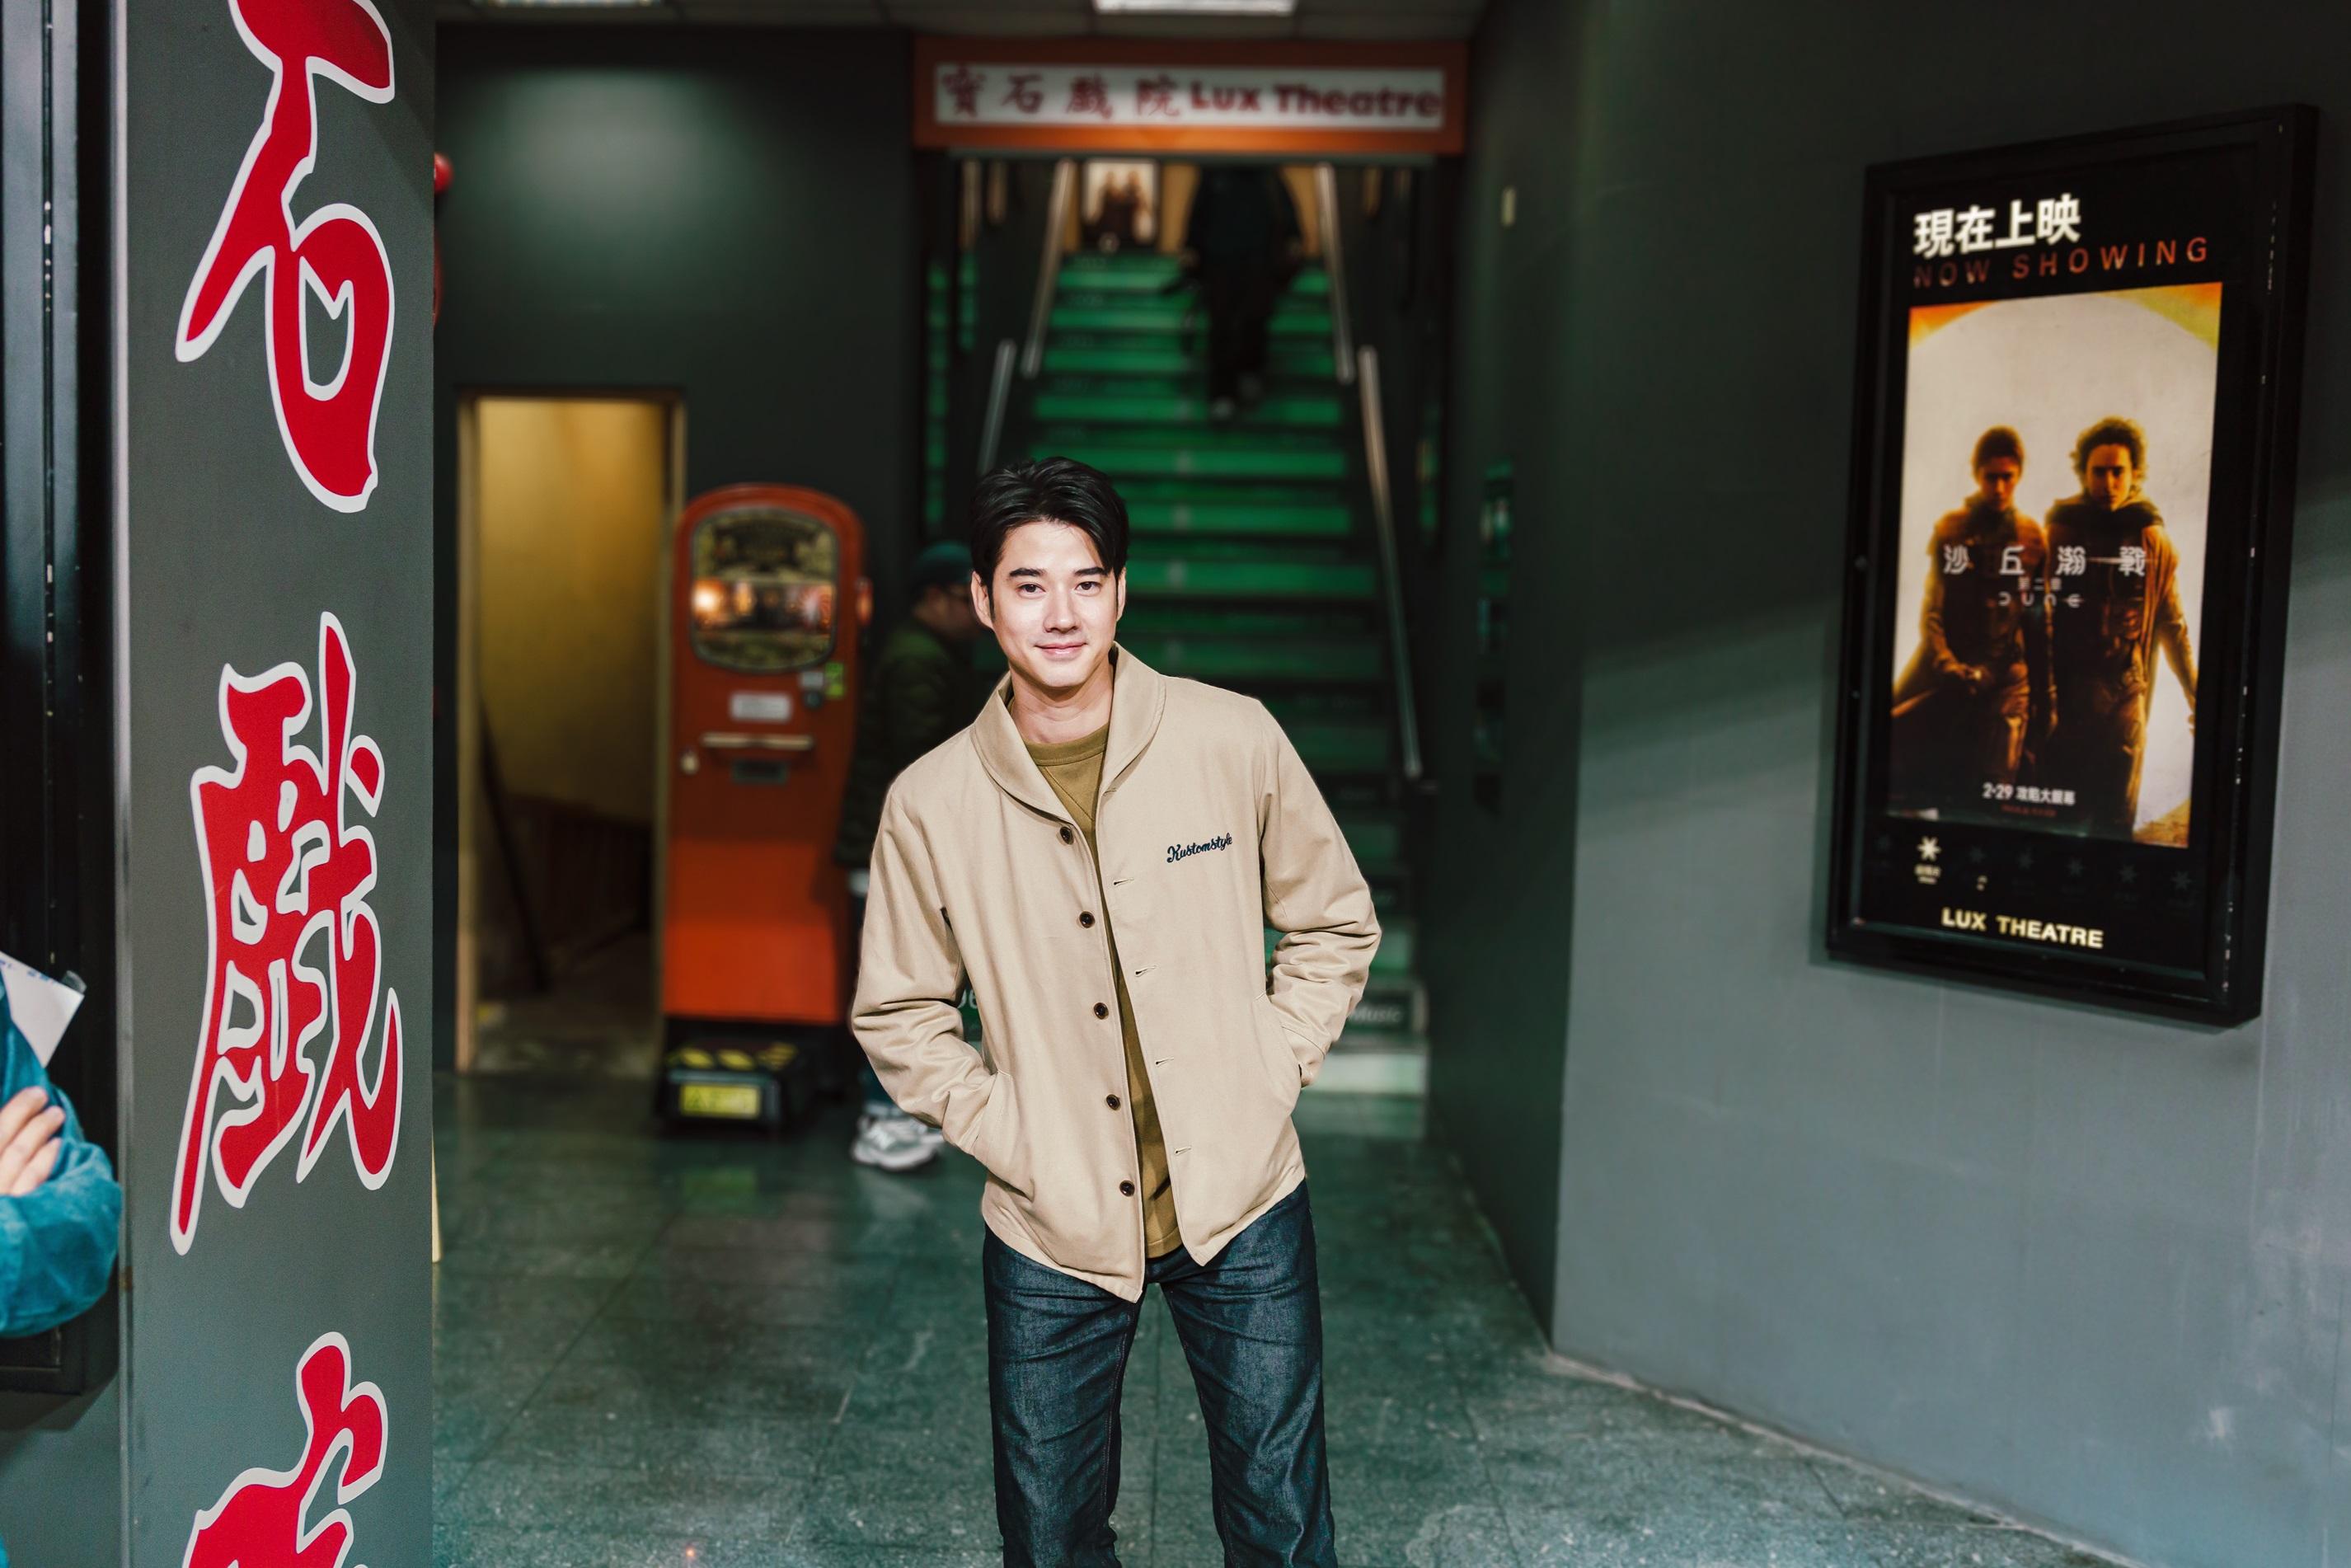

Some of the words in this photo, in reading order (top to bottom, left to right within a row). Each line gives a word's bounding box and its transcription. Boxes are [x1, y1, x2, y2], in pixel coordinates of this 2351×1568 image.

[1190, 81, 1261, 110] Lux
[1273, 84, 1441, 117] Theatre
[1912, 192, 2081, 259] 現在上映
[1912, 258, 1992, 288] NOW
[2012, 236, 2209, 279] SHOWING
[1941, 907, 1987, 932] LUX
[1996, 914, 2105, 949] THEATRE
